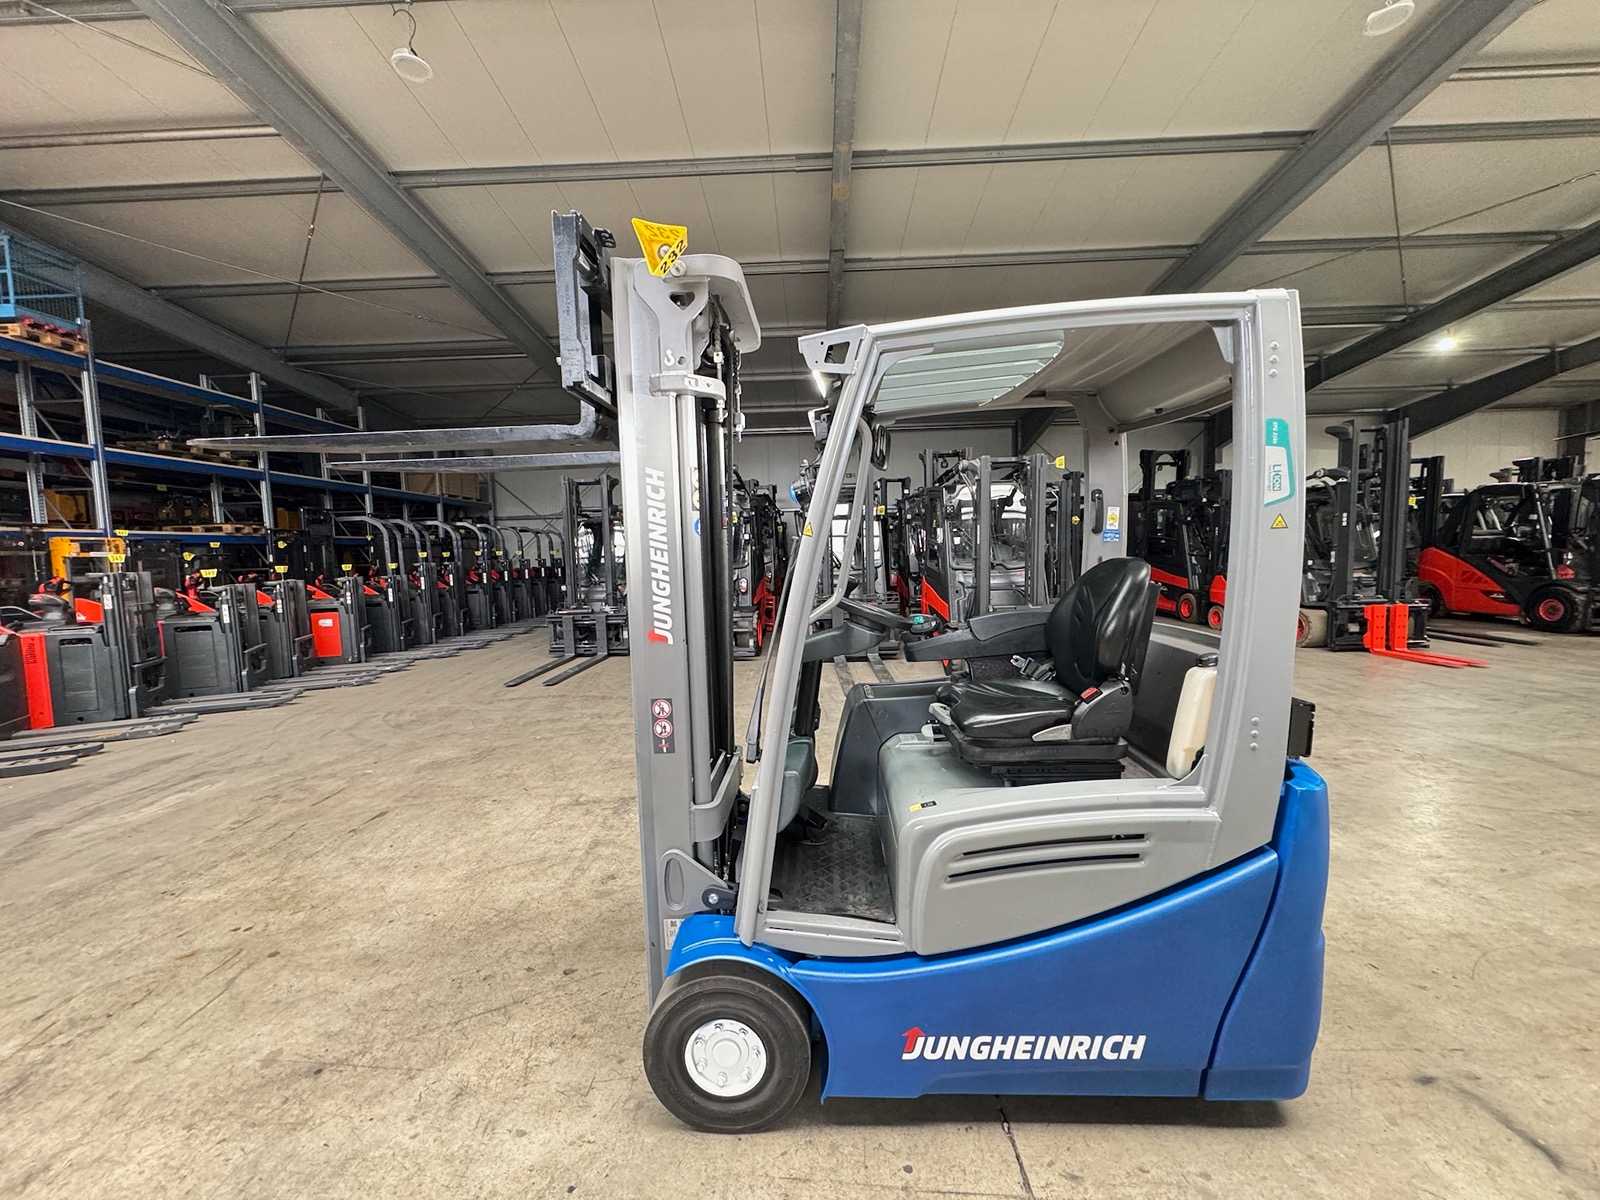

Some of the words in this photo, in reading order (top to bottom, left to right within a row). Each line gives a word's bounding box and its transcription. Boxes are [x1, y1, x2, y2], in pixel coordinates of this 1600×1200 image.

[660, 239, 686, 274] 232
[646, 467, 674, 646] JUNGHEINRICH
[901, 1030, 1148, 1061] JUNGHEINRICH
